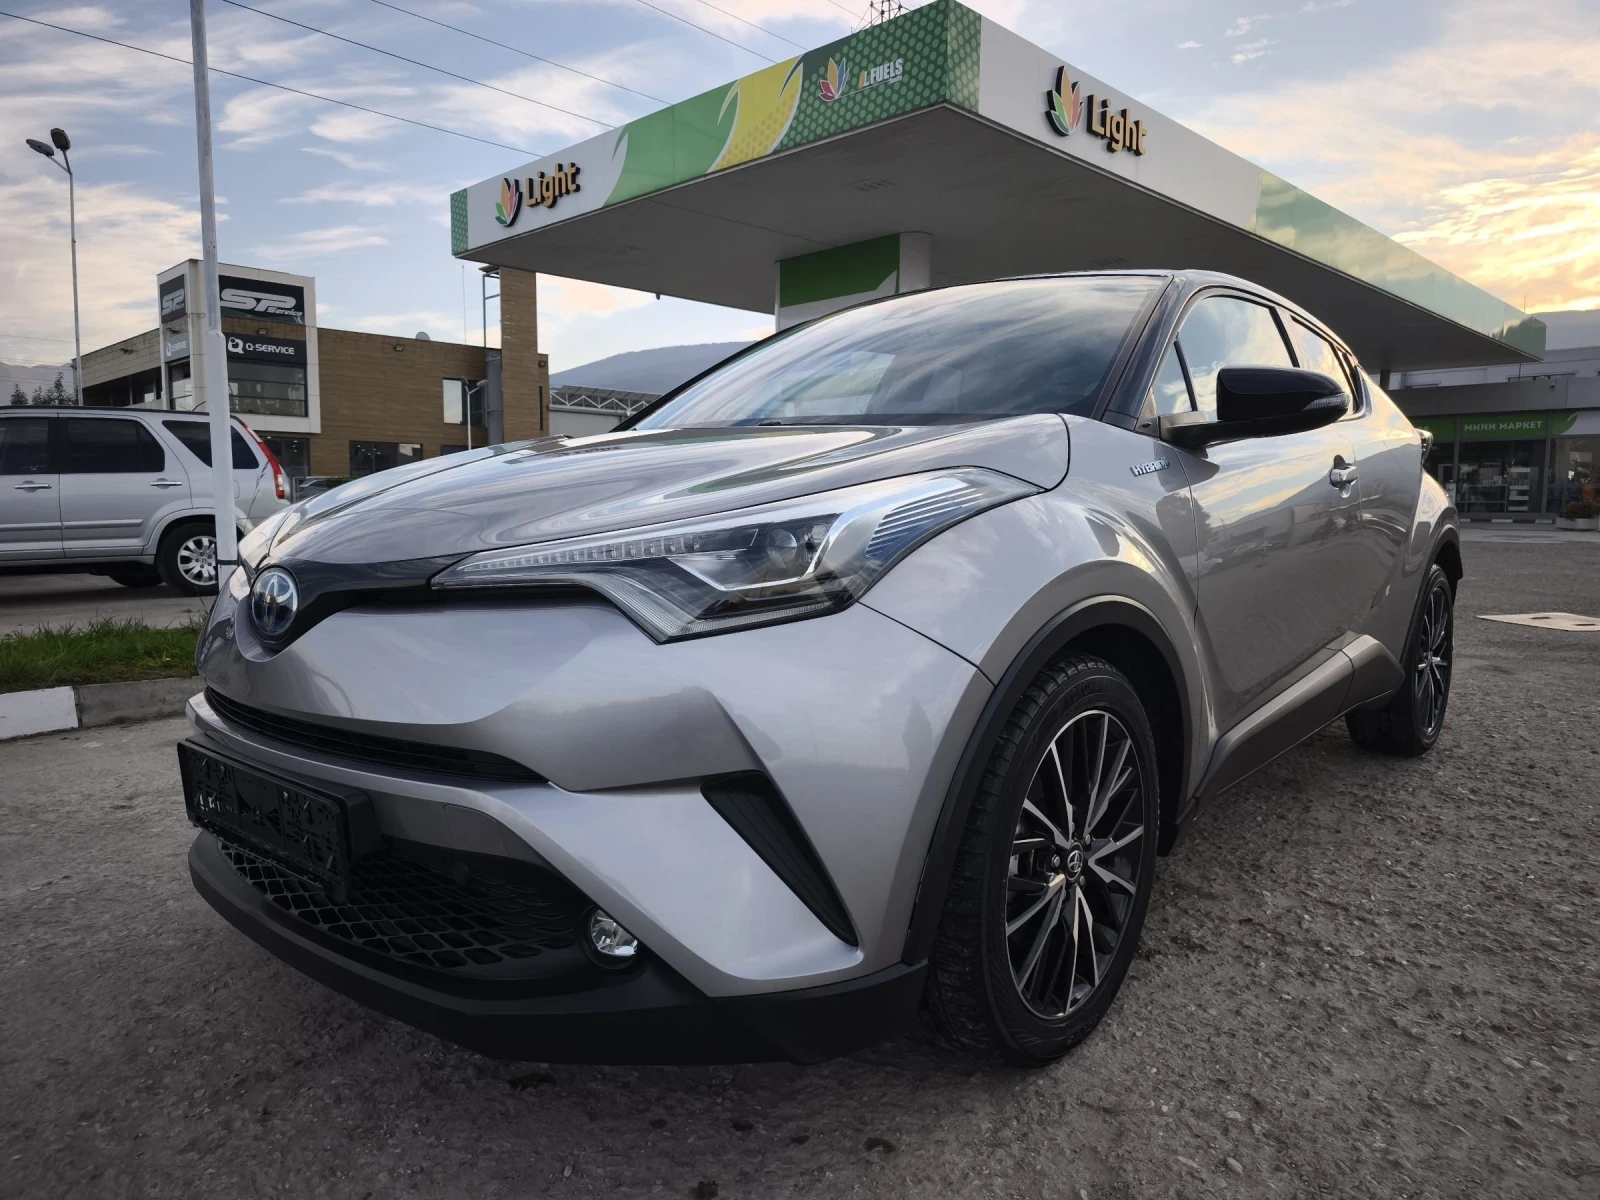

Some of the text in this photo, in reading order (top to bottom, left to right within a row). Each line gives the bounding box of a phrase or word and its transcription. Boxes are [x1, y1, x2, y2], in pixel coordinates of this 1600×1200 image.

[870, 58, 903, 84] FUELS
[1087, 94, 1148, 157] Light
[525, 162, 581, 208] Light
[220, 288, 297, 312] SP
[266, 306, 304, 317] Service
[245, 342, 295, 355] Q-SERVICE
[1464, 420, 1543, 432] МИНИ МАРКЕТ
